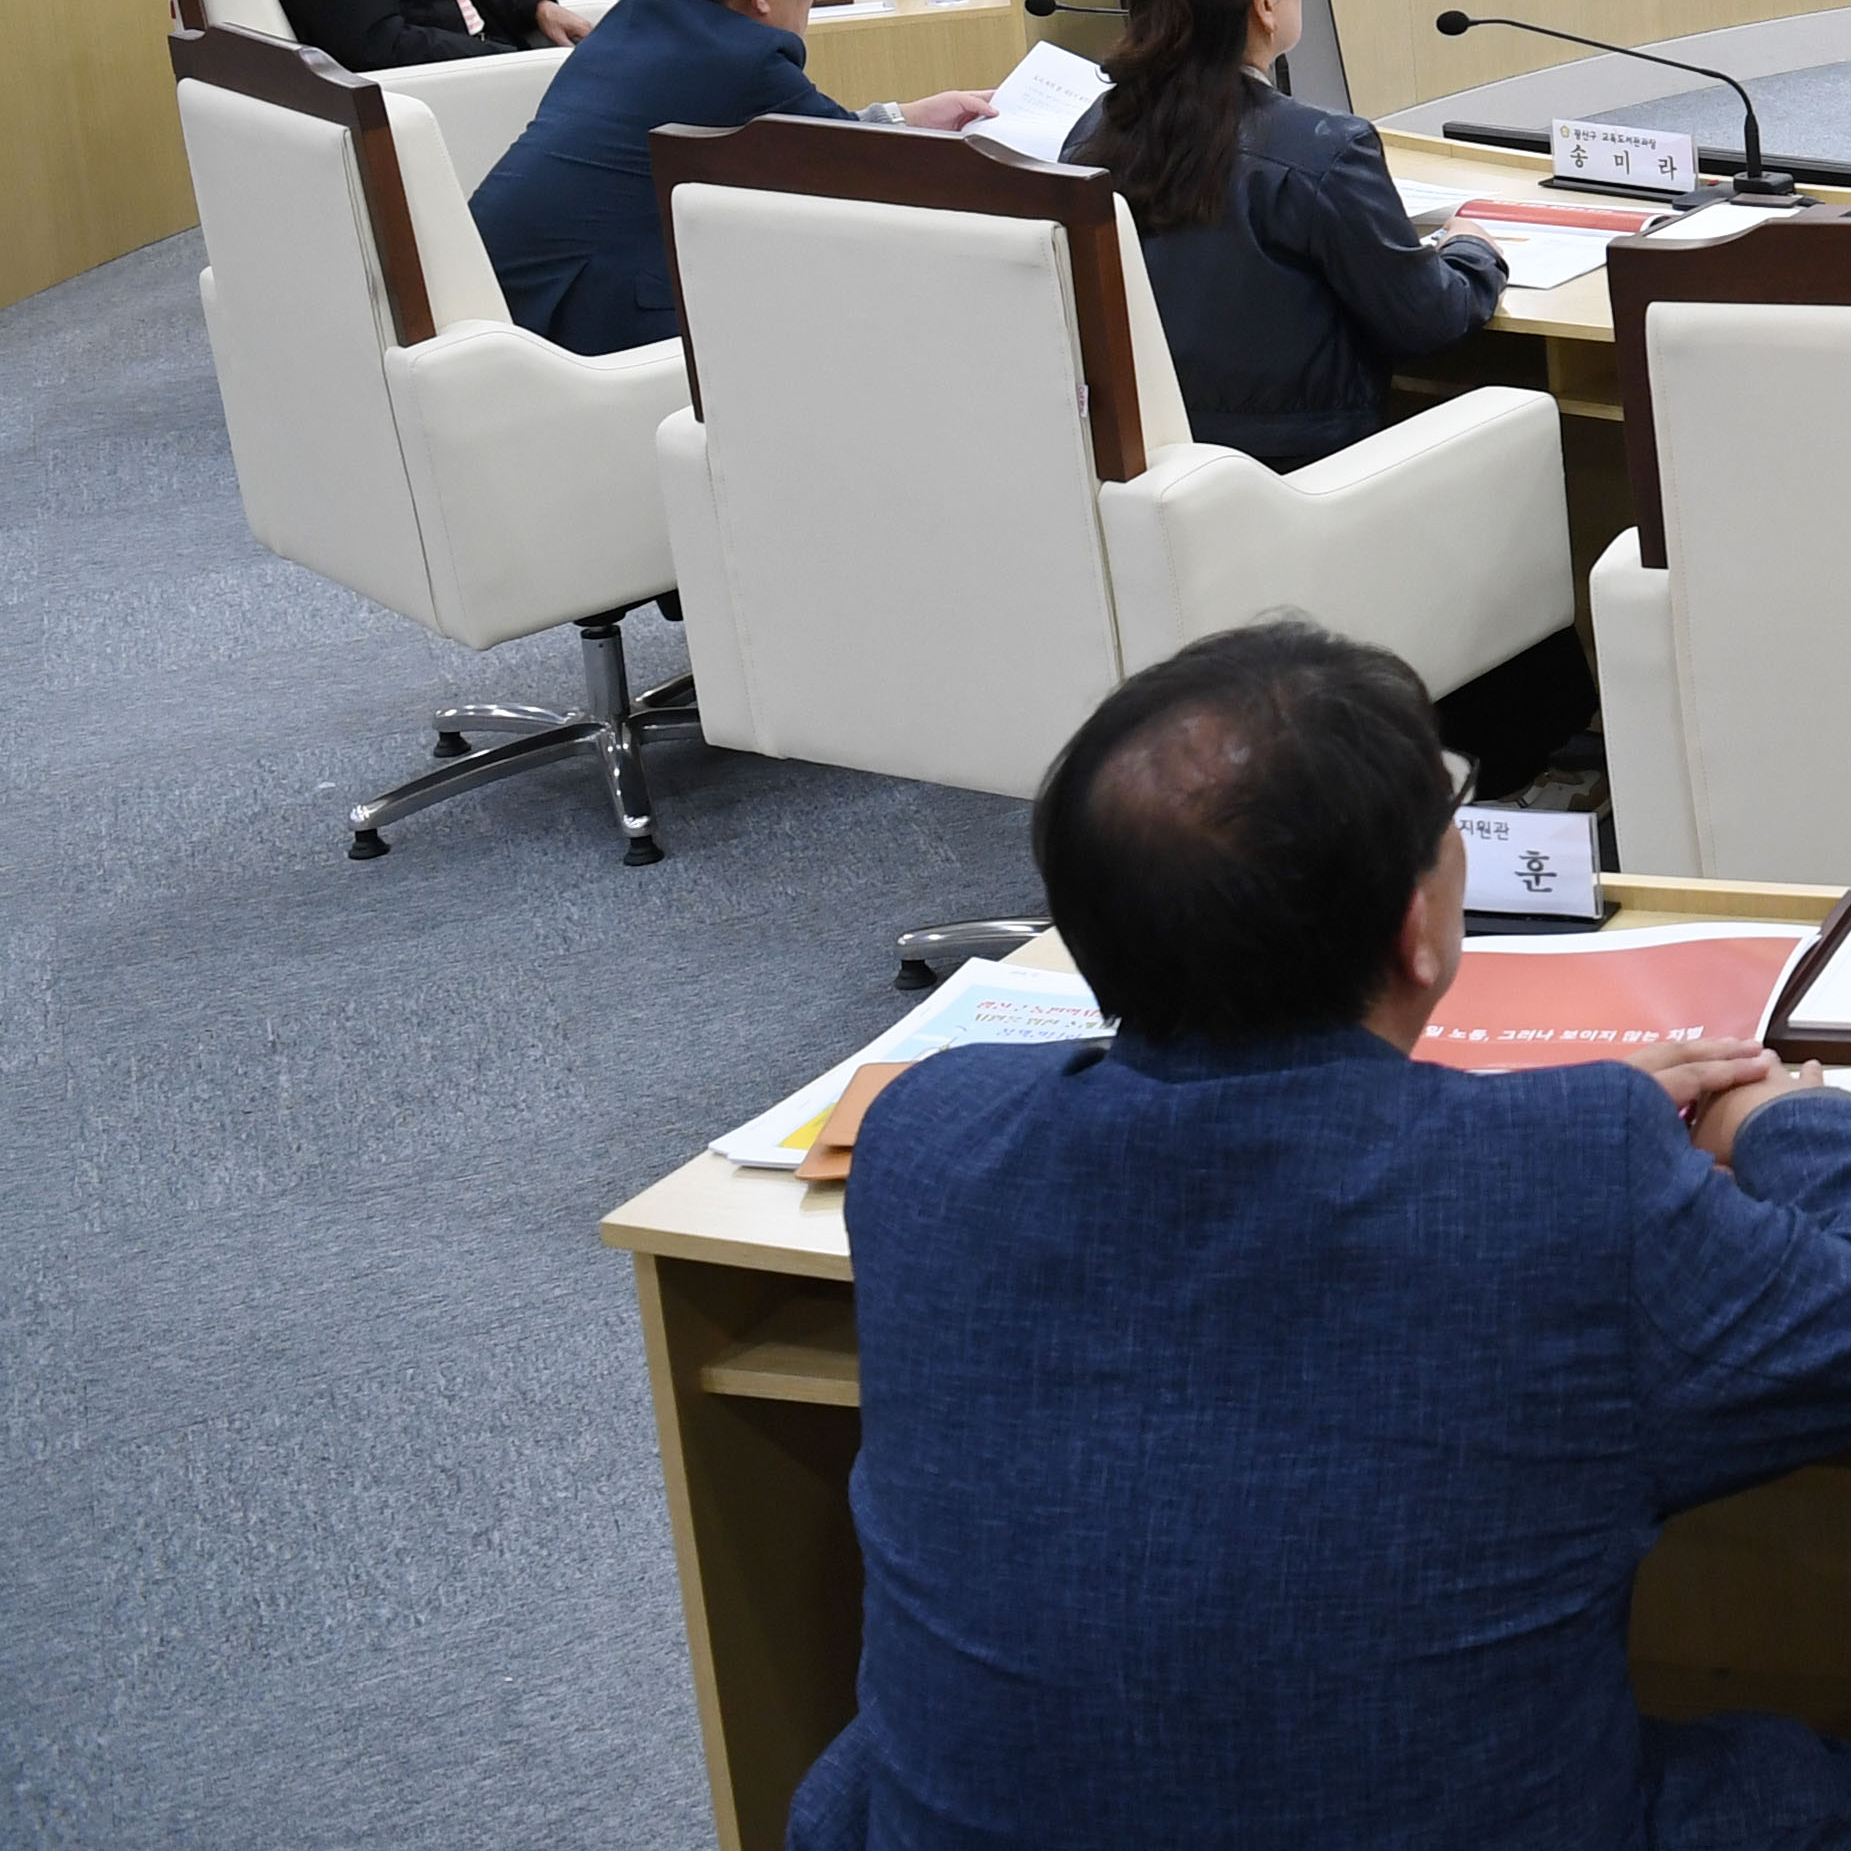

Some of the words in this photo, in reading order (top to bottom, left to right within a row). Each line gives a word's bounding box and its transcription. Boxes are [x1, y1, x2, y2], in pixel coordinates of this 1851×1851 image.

[1570, 144, 1589, 168] 송
[1613, 149, 1630, 175] 미
[1657, 155, 1678, 181] 라
[1514, 850, 1558, 893] 훈
[1497, 1028, 1555, 1042] 그러나
[1560, 1029, 1617, 1042] 보이지
[1622, 1029, 1660, 1043] 않는
[1666, 1025, 1705, 1042] 차별
